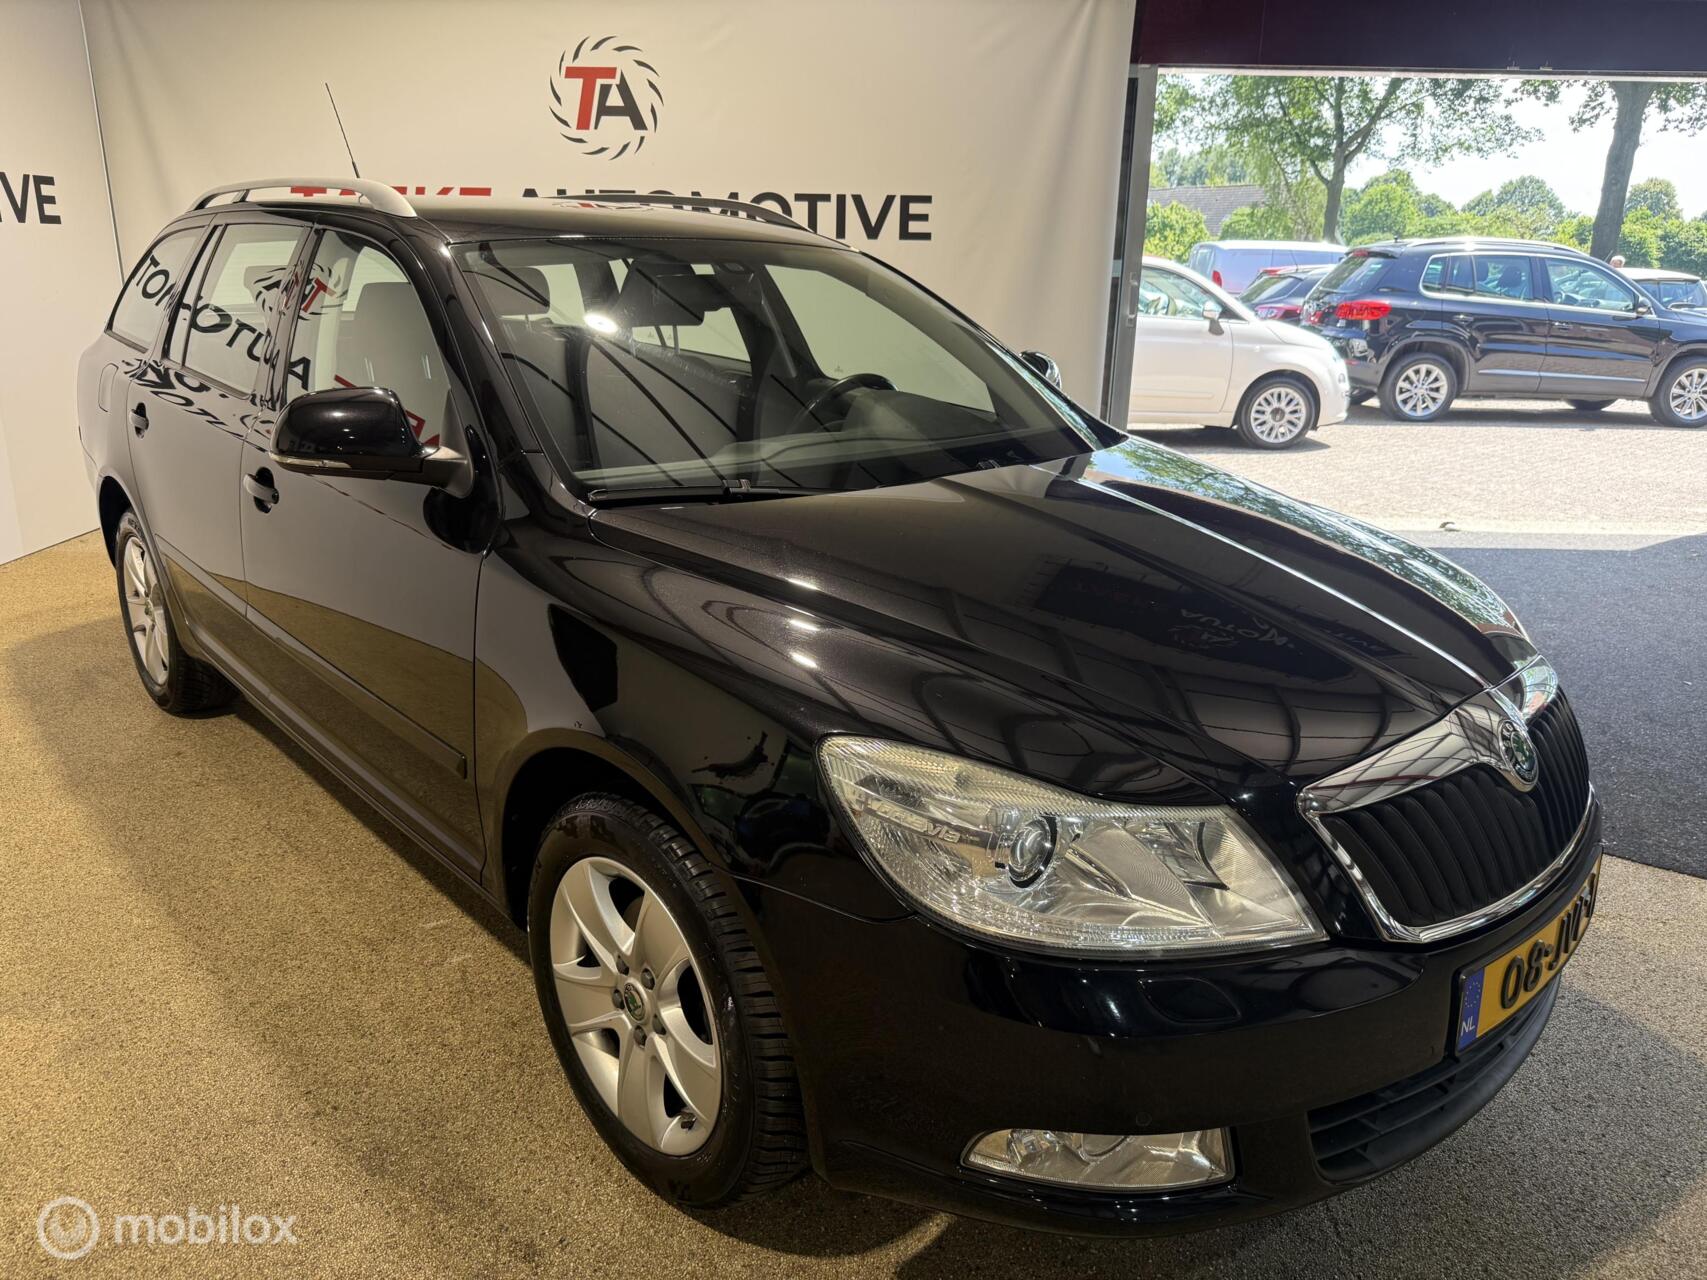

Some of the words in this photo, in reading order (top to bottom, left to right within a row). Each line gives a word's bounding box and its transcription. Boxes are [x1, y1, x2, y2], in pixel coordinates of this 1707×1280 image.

[564, 66, 648, 131] TA
[0, 171, 62, 225] VE
[1460, 1015, 1476, 1037] NL
